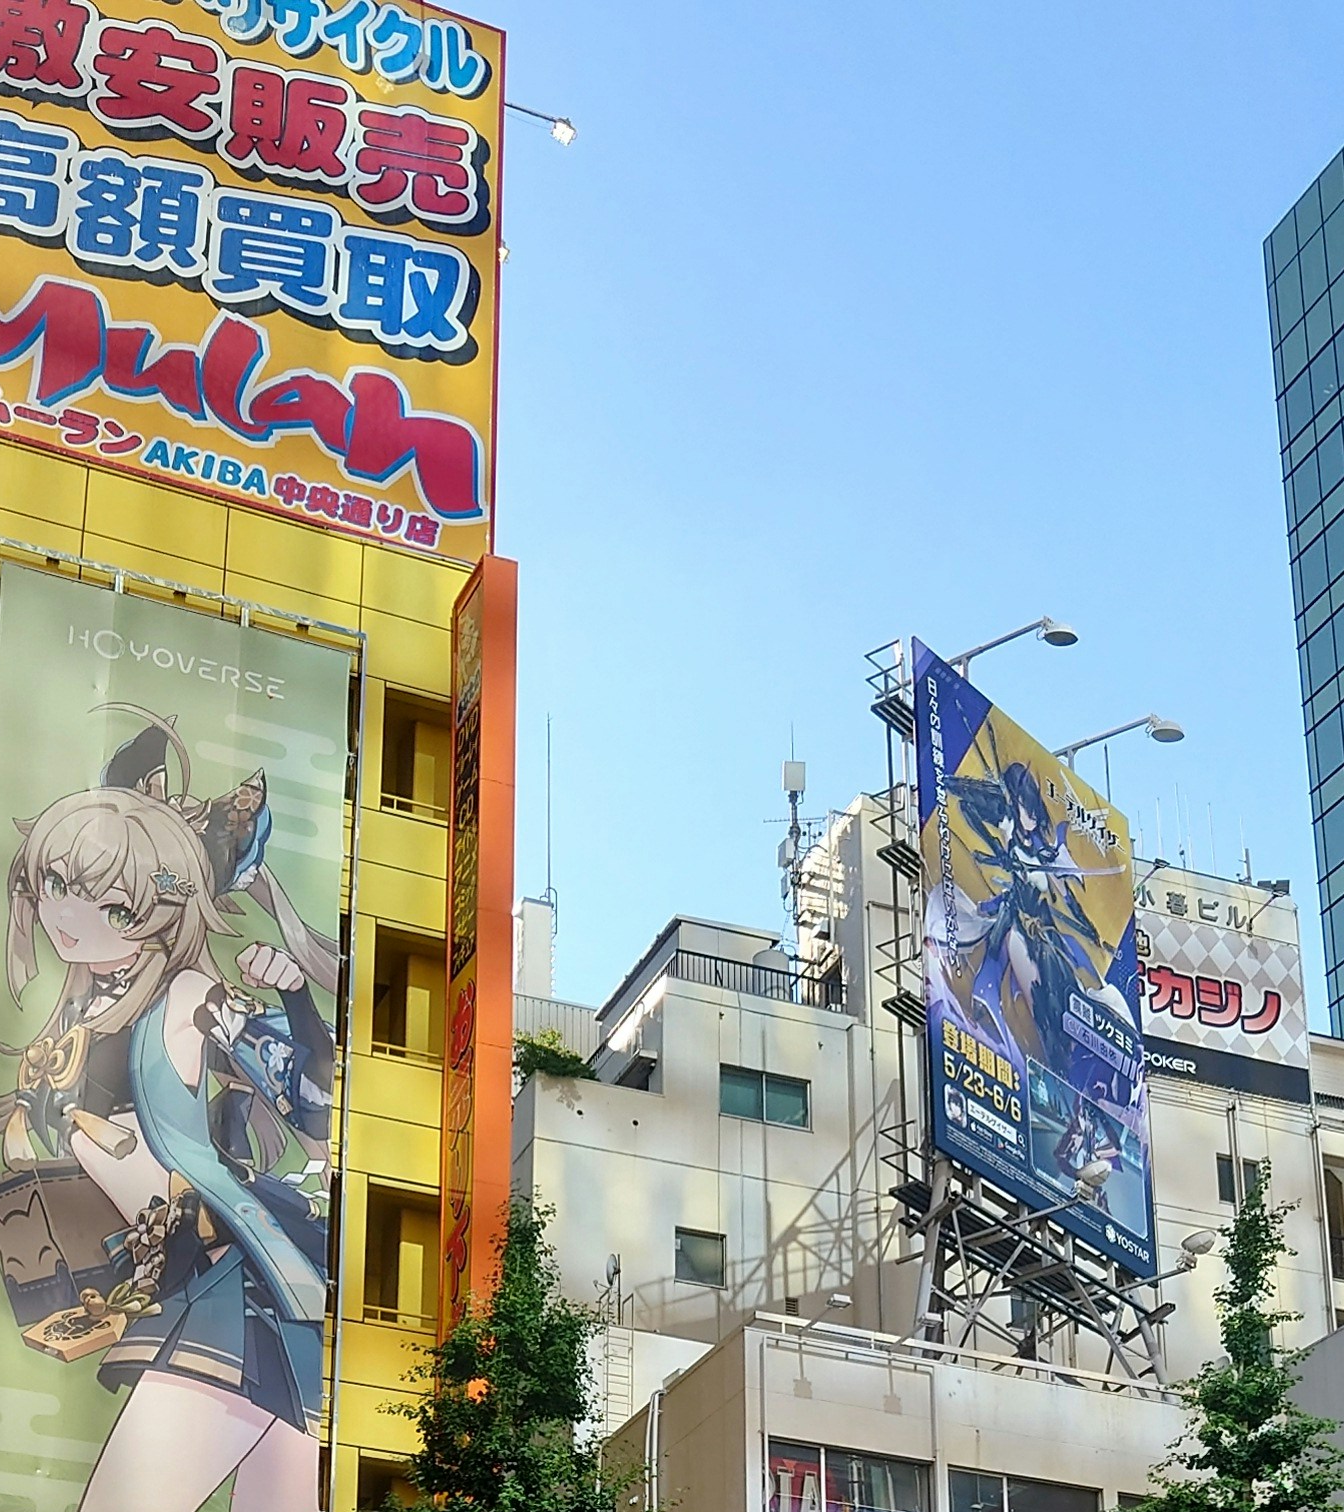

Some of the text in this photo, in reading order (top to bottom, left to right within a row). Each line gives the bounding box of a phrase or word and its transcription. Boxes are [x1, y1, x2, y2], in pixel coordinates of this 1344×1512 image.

[144, 441, 267, 498] AKIBA
[67, 624, 286, 700] HOYOVERSE
[1137, 960, 1282, 1035] カジノ
[1094, 1013, 1134, 1055] ツクヨミ
[1142, 1050, 1197, 1075] POKER
[1114, 1232, 1150, 1264] YOSTAR
